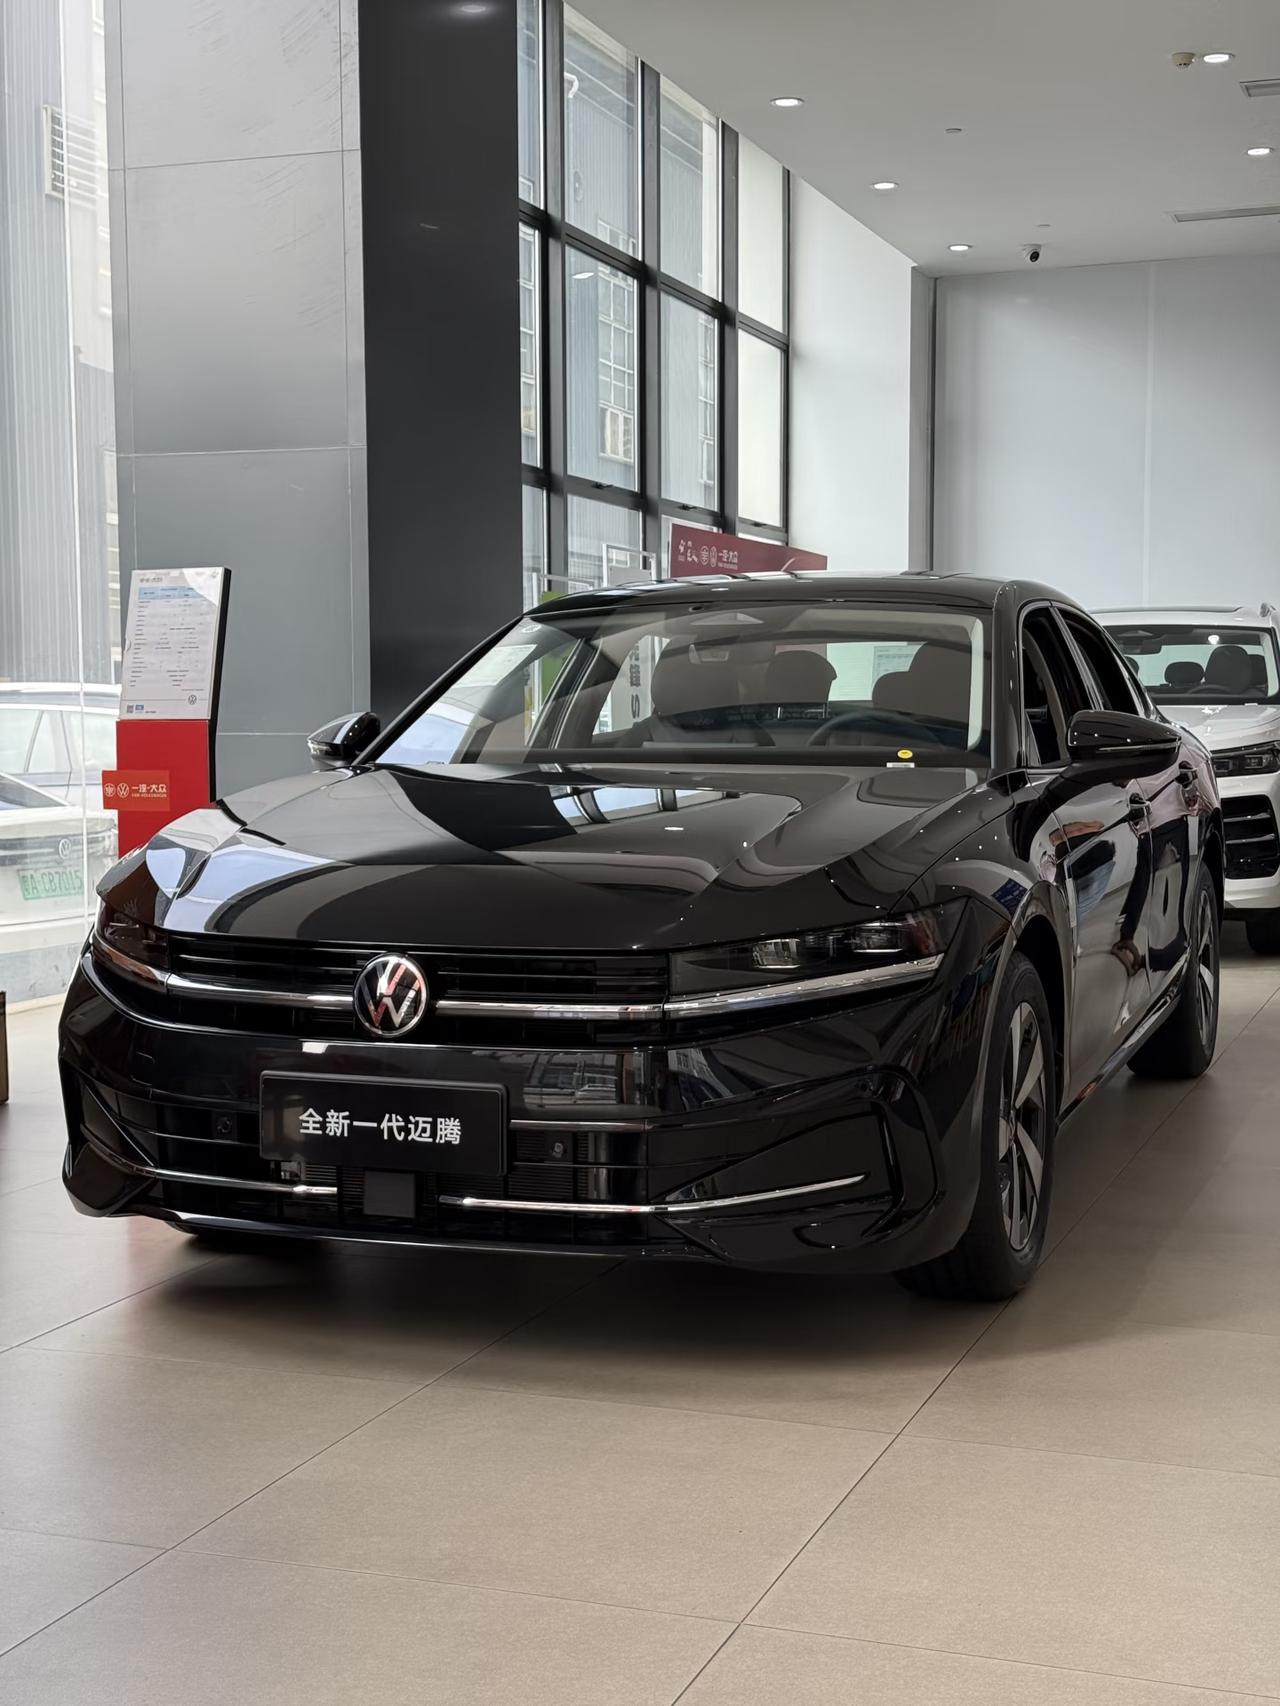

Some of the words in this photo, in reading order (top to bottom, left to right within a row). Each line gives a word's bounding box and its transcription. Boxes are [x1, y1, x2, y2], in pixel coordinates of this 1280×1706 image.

[298, 1107, 462, 1145] 全新一代迈腾
